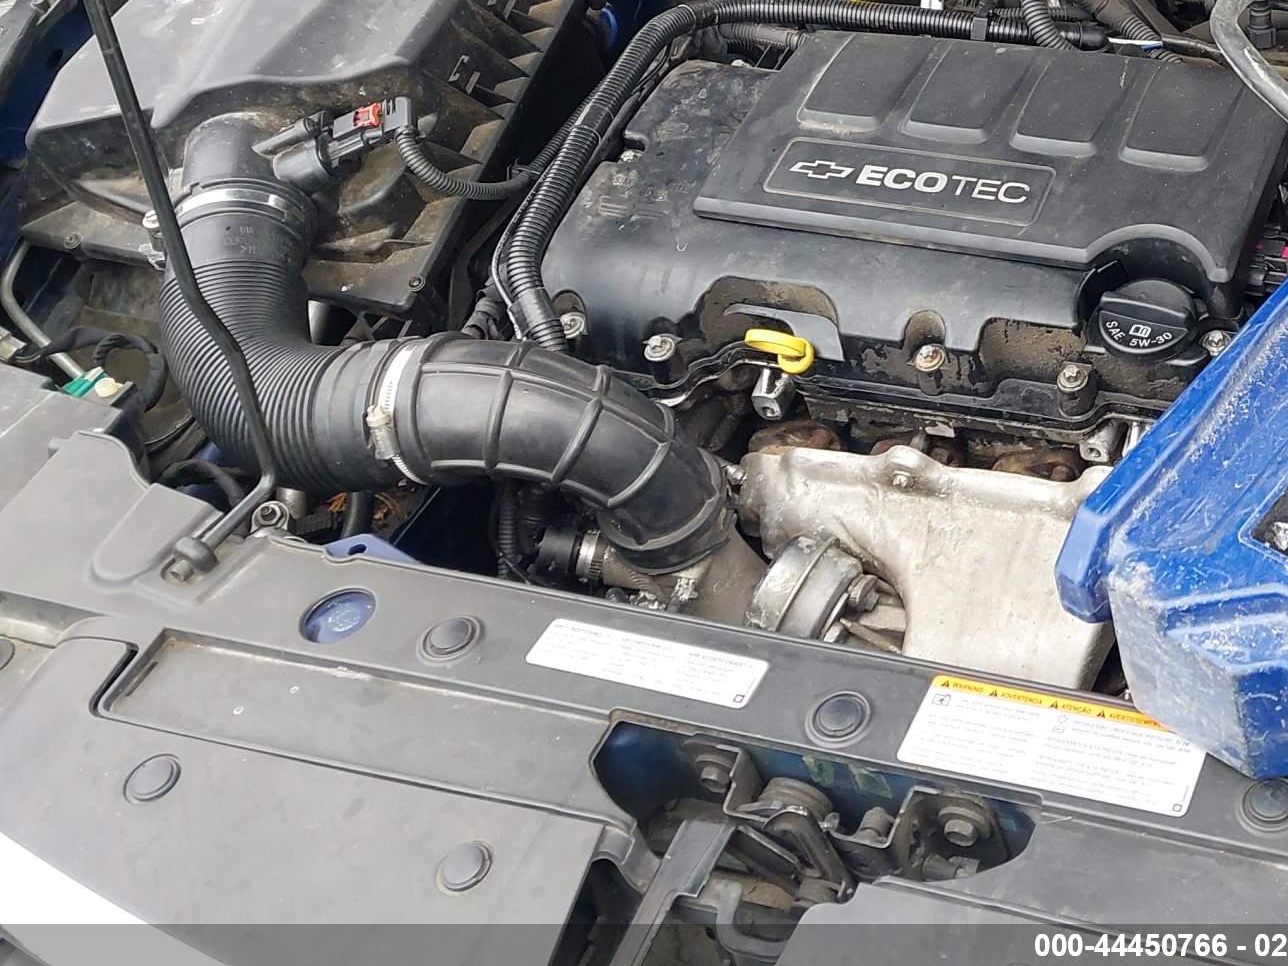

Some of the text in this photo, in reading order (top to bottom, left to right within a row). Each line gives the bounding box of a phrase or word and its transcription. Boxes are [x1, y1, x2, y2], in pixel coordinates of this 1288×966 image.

[855, 164, 1031, 204] ECOTEC
[1105, 320, 1173, 347] SAE 5W-30
[952, 681, 984, 693] WARNING
